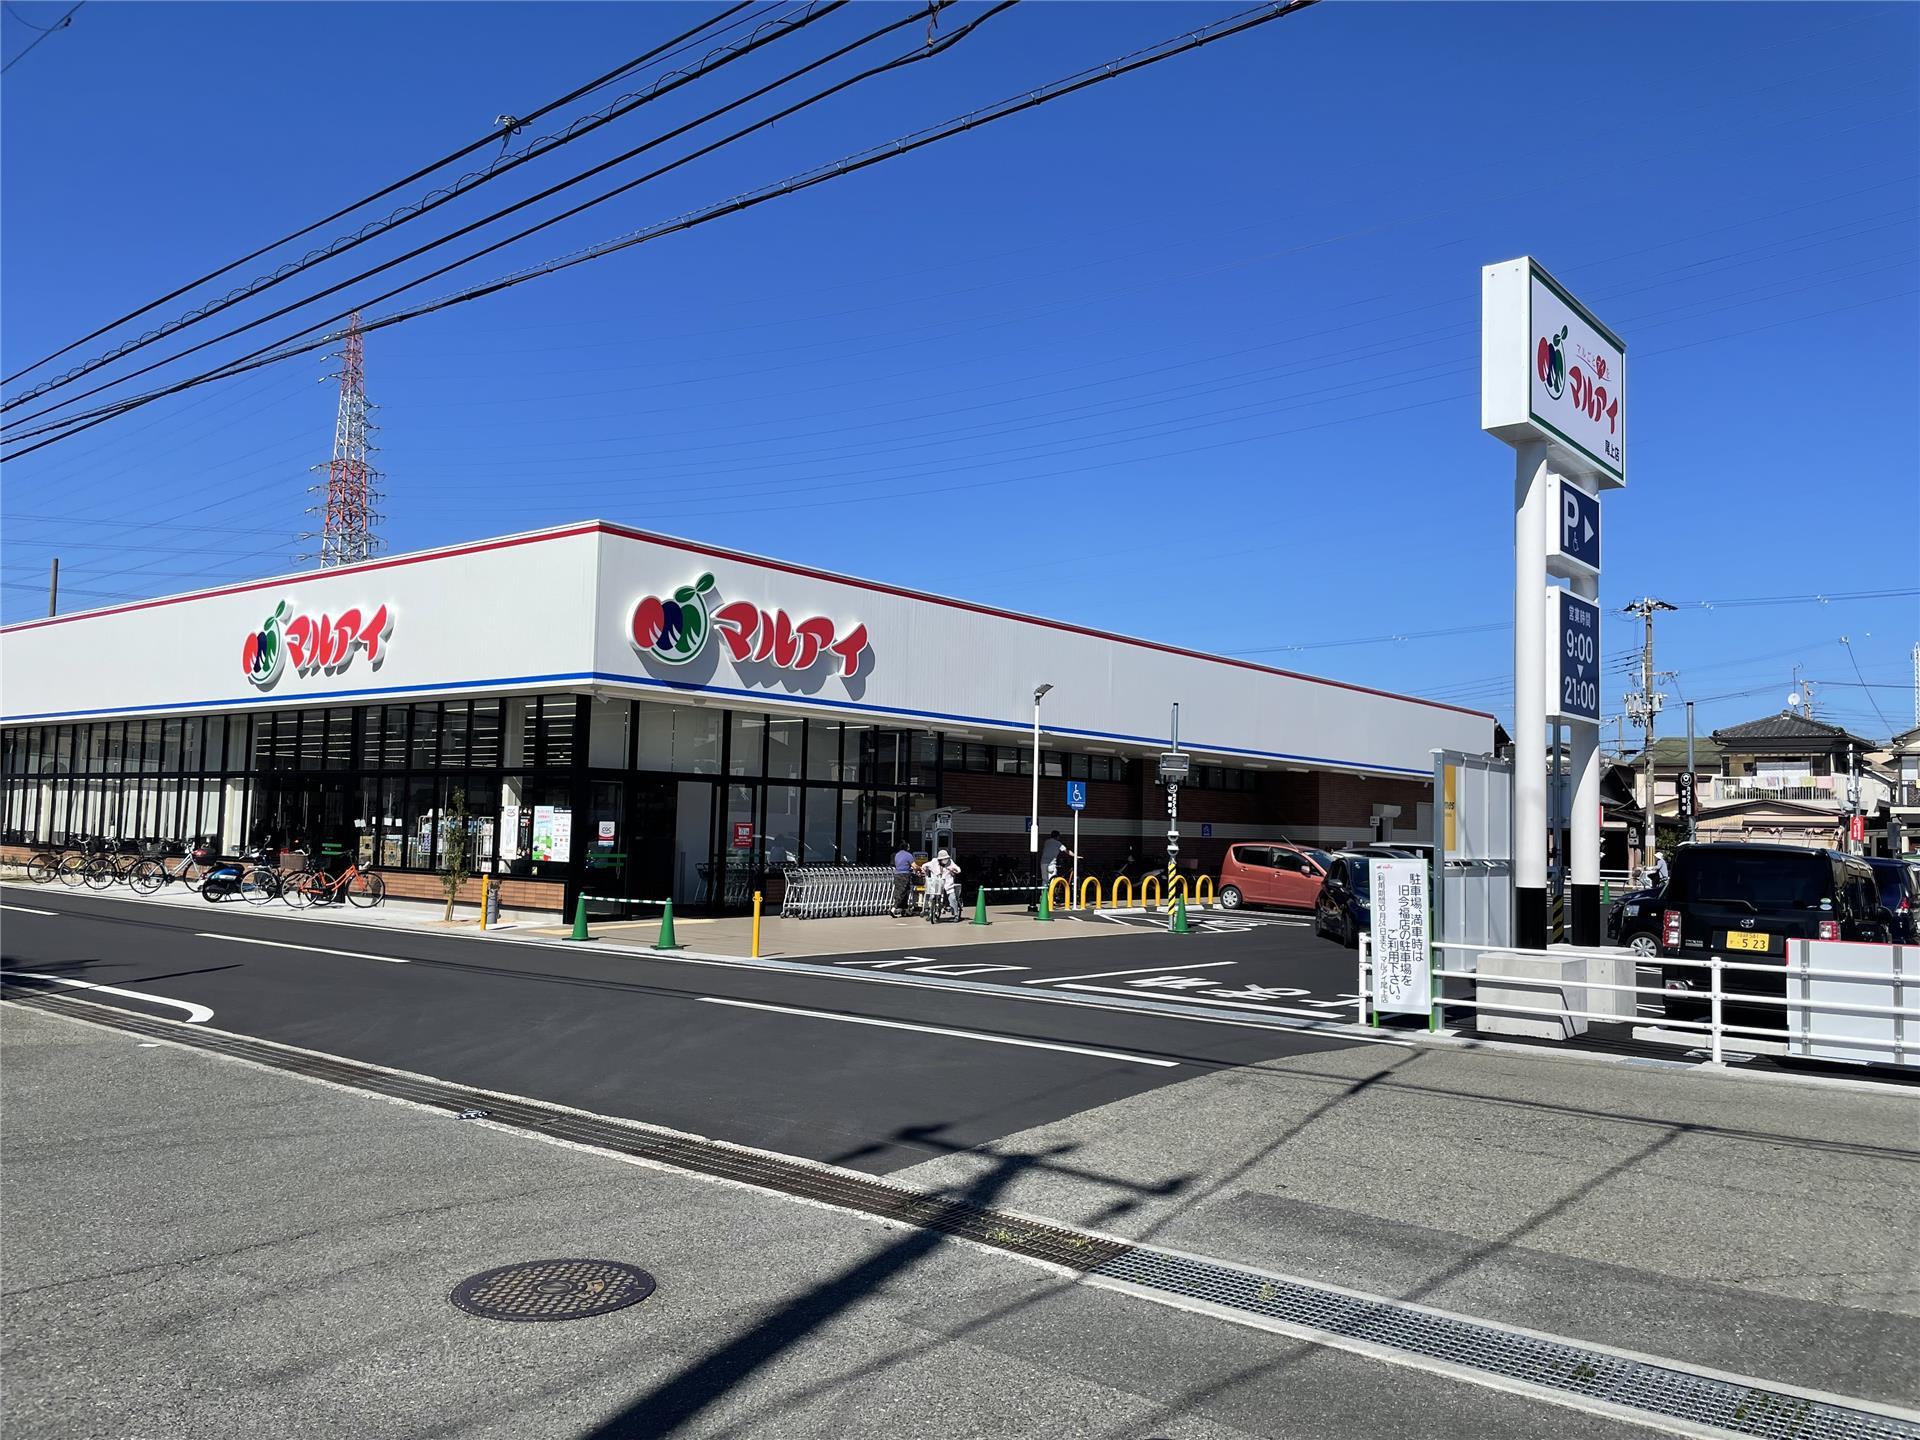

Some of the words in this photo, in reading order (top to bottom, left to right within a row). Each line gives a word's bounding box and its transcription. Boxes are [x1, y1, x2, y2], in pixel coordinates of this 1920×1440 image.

[1569, 366, 1618, 434] マルアイ
[1563, 490, 1579, 547] P
[285, 604, 387, 668] マルアイ
[714, 600, 868, 676] マルアイ
[1566, 628, 1593, 664] 9:00
[1568, 604, 1591, 628] 営業時間
[1564, 675, 1596, 711] 21:00
[1398, 884, 1413, 986] 旧今福店の駐車場を
[1410, 873, 1424, 962] 駐車場、満車時は
[1387, 929, 1401, 1000] ご利用下さい。
